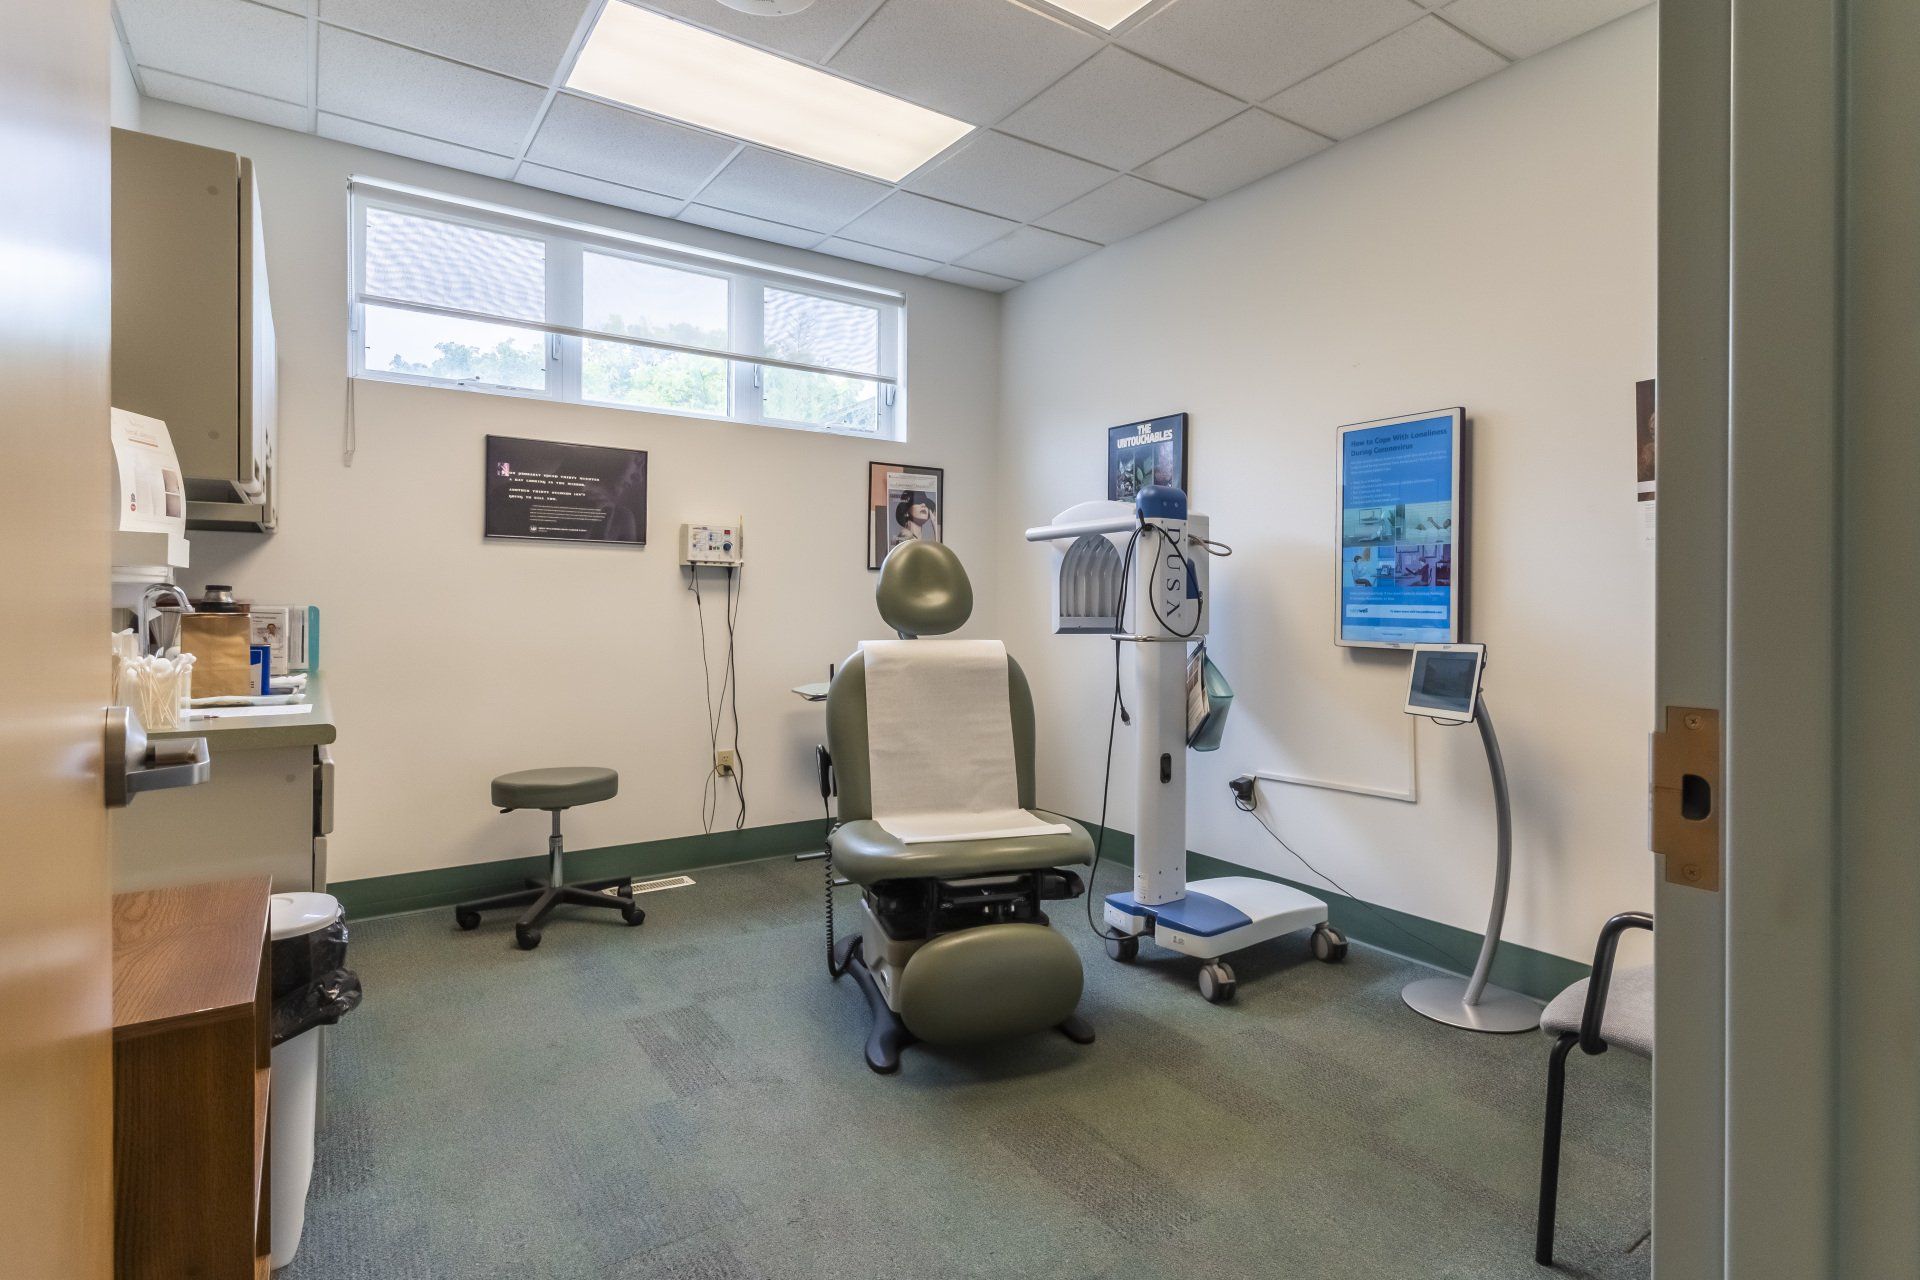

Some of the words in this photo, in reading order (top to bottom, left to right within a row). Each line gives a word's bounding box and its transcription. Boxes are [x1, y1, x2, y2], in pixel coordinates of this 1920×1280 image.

[1136, 423, 1152, 435] THE
[1374, 437, 1391, 445] Cope
[1392, 433, 1409, 441] With
[1411, 429, 1448, 439] Loneliness
[1117, 429, 1173, 448] UNTOUCHABLES
[1350, 448, 1373, 457] During
[1373, 443, 1414, 454] Coronavirus
[1166, 527, 1181, 618] DUSA
